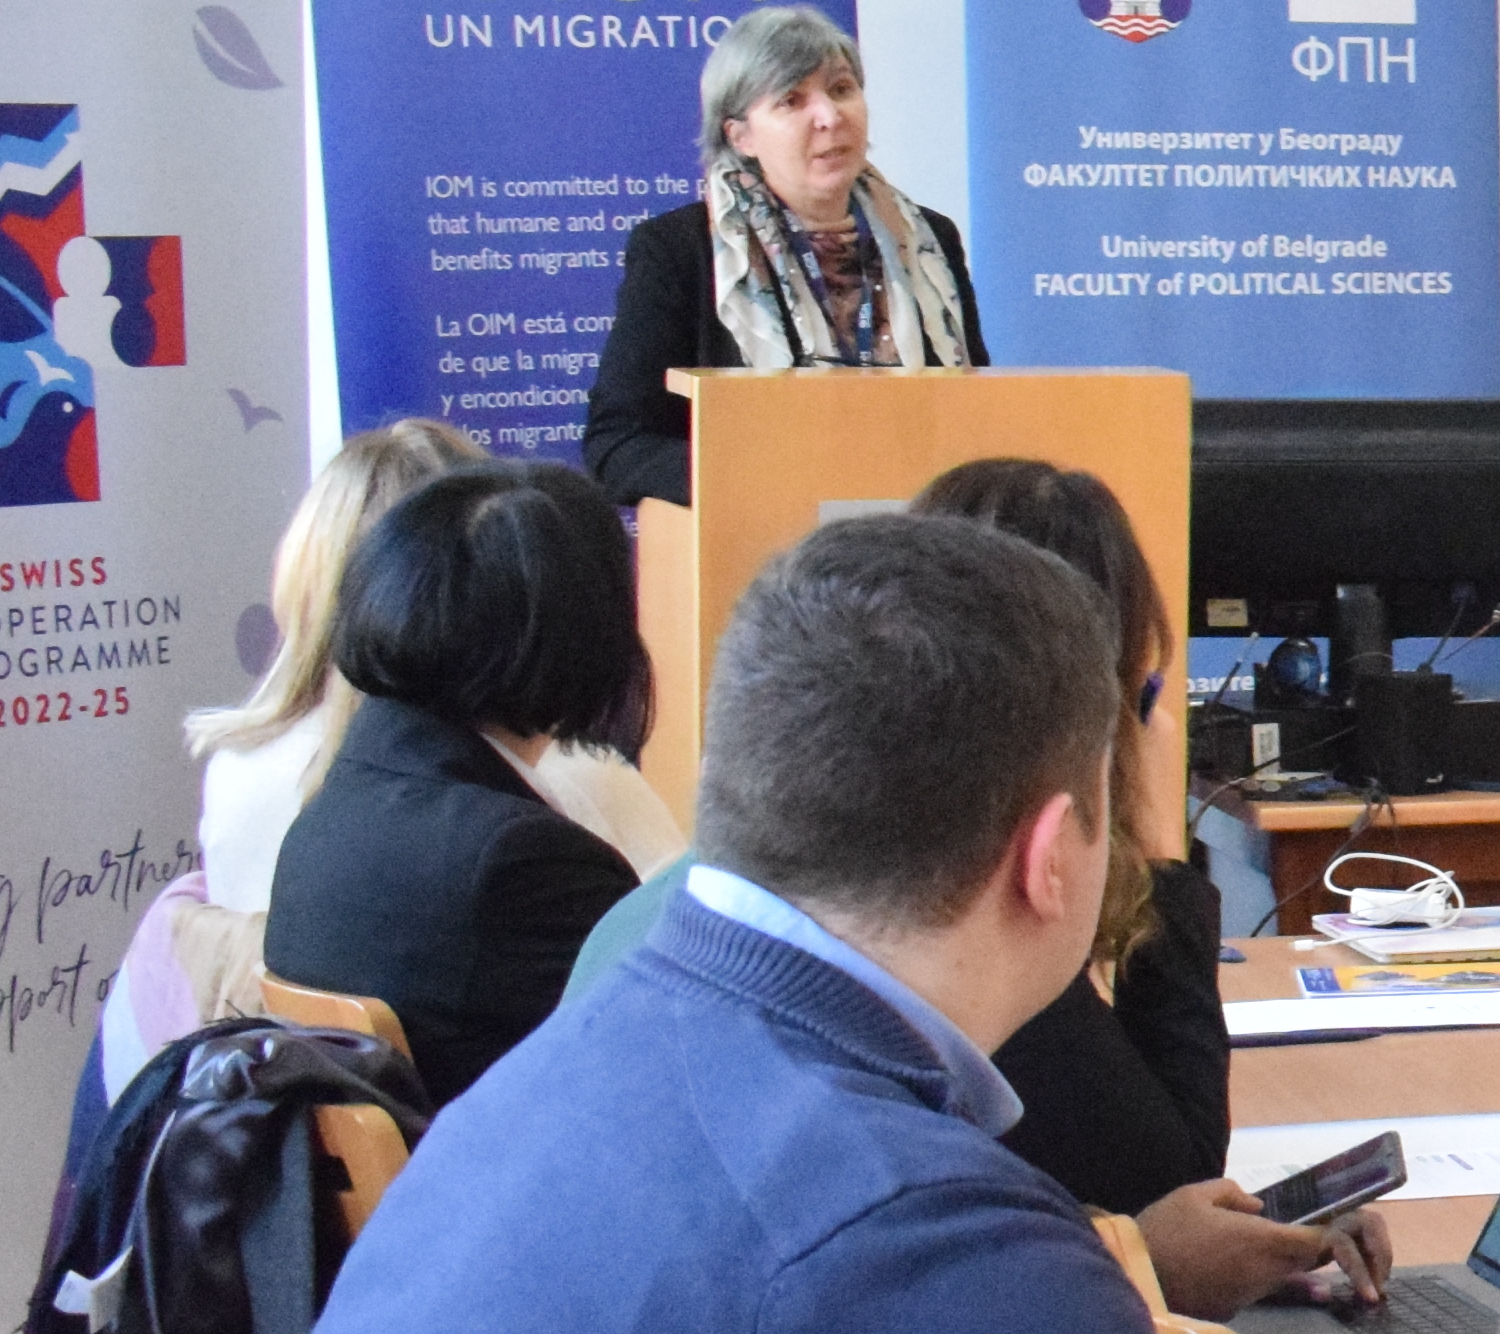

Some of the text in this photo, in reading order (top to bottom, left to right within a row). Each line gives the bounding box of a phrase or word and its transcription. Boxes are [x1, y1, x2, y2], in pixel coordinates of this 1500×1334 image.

[425, 14, 735, 48] UN MIGRATIO
[1290, 35, 1417, 83] ФПН
[1078, 124, 1253, 155] Универзитет
[1279, 127, 1402, 157] Београду
[425, 174, 474, 199] IOM
[481, 176, 498, 198] is
[504, 174, 619, 198] committed
[625, 176, 649, 196] to
[655, 173, 689, 195] the
[1023, 162, 1457, 190] ФАКУЛТЕТ ПОЛИТИЧКИХ НАУКА
[428, 213, 470, 235] that
[476, 211, 560, 235] humane
[567, 209, 605, 232] and
[431, 247, 512, 272] benefits
[520, 247, 609, 275] migrants
[1101, 234, 1388, 264] University of Belgrade
[1034, 270, 1453, 297] FACULTY of POLITICAL SCIENCES
[436, 315, 461, 337] La
[468, 312, 516, 336] OIM
[523, 311, 567, 334] está
[438, 348, 601, 378] de que la migra
[440, 394, 454, 417] y
[499, 422, 586, 449] migrante
[0, 556, 108, 592] SWISS
[0, 595, 182, 637] PERATION
[38, 829, 204, 944] partner
